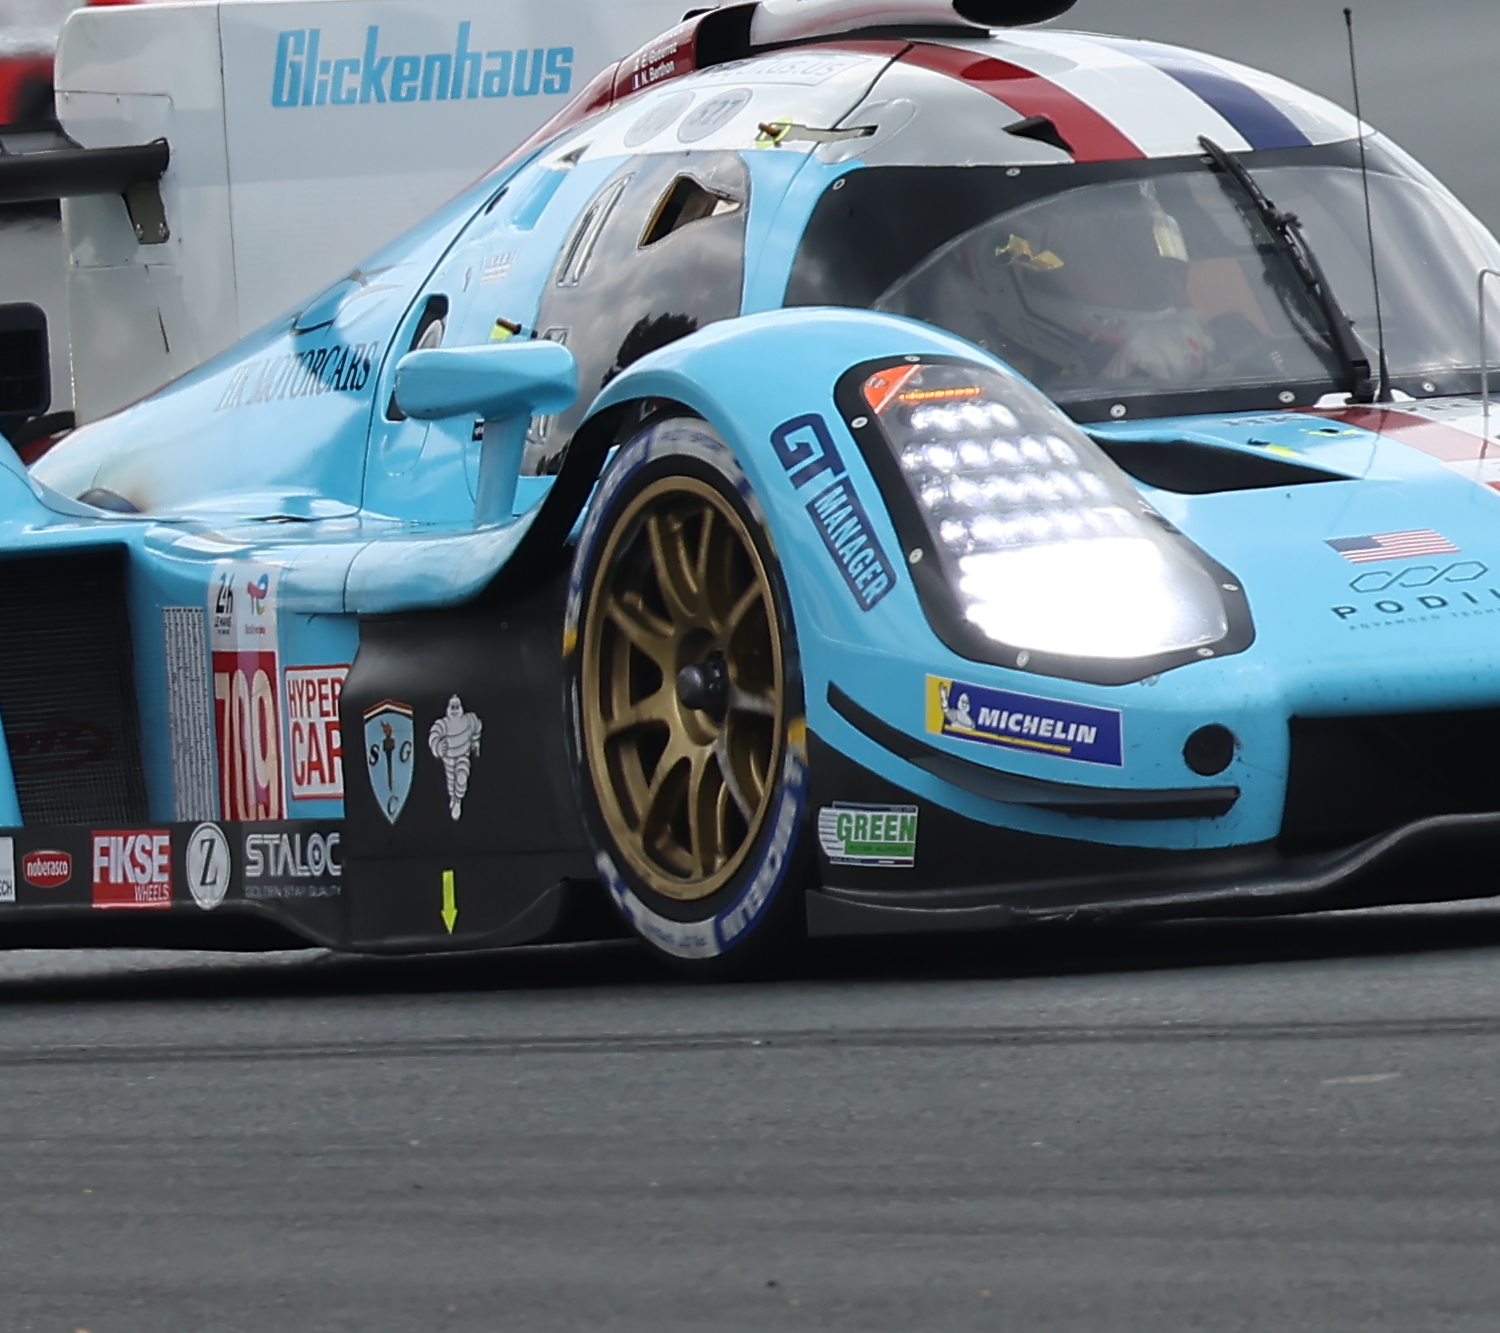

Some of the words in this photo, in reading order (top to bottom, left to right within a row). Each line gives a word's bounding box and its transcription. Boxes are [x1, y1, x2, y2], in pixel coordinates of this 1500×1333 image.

[271, 21, 574, 108] Glickenhaus
[247, 341, 380, 405] MOTORCARS
[770, 412, 847, 490] GT
[814, 485, 890, 605] MANAGER
[214, 668, 279, 821] 709
[977, 706, 1098, 744] MICHELIN
[368, 743, 381, 767] S
[399, 740, 412, 764] G
[836, 813, 916, 842] GREEN
[26, 859, 69, 877] noberasco
[92, 834, 171, 884] FIKSE
[245, 833, 342, 877] STALOC
[134, 884, 170, 902] WHEELS
